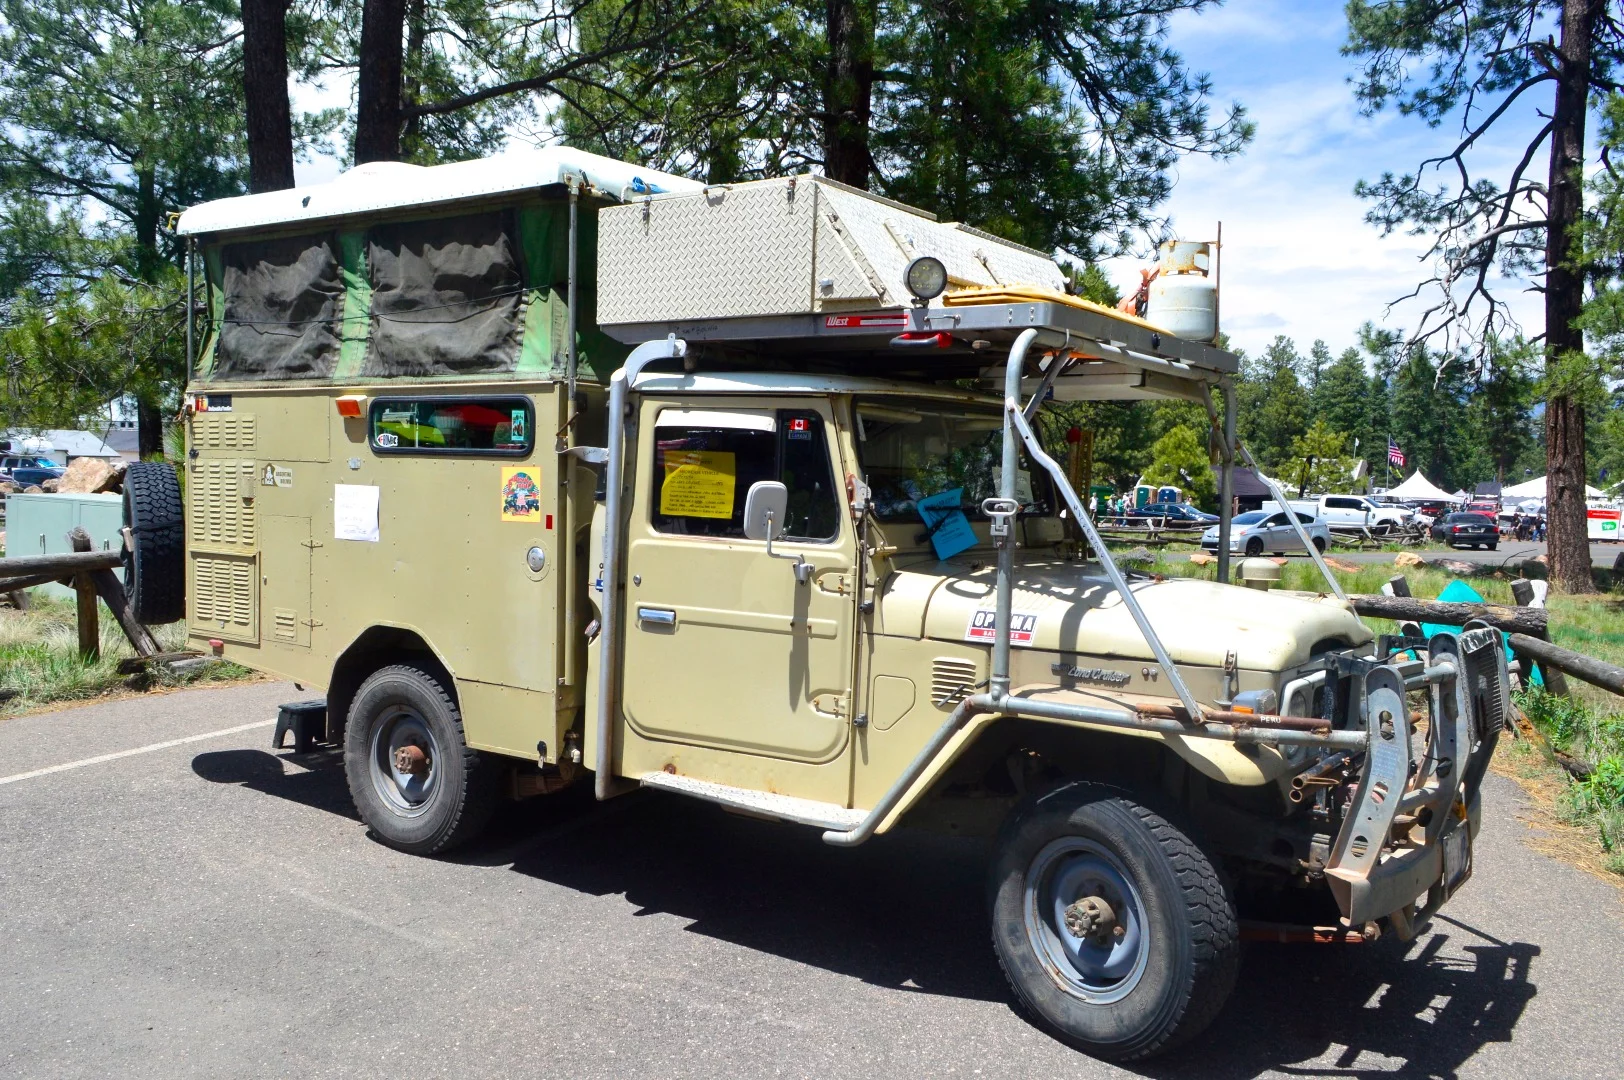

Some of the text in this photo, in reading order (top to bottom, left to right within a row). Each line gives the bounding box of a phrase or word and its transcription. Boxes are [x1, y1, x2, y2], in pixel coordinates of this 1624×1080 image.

[826, 316, 849, 326] West
[975, 613, 1034, 631] OPMA
[983, 631, 1020, 639] BATES
[1068, 667, 1092, 679] Land
[1091, 668, 1128, 683] Cruiser
[1260, 716, 1281, 724] PERU
